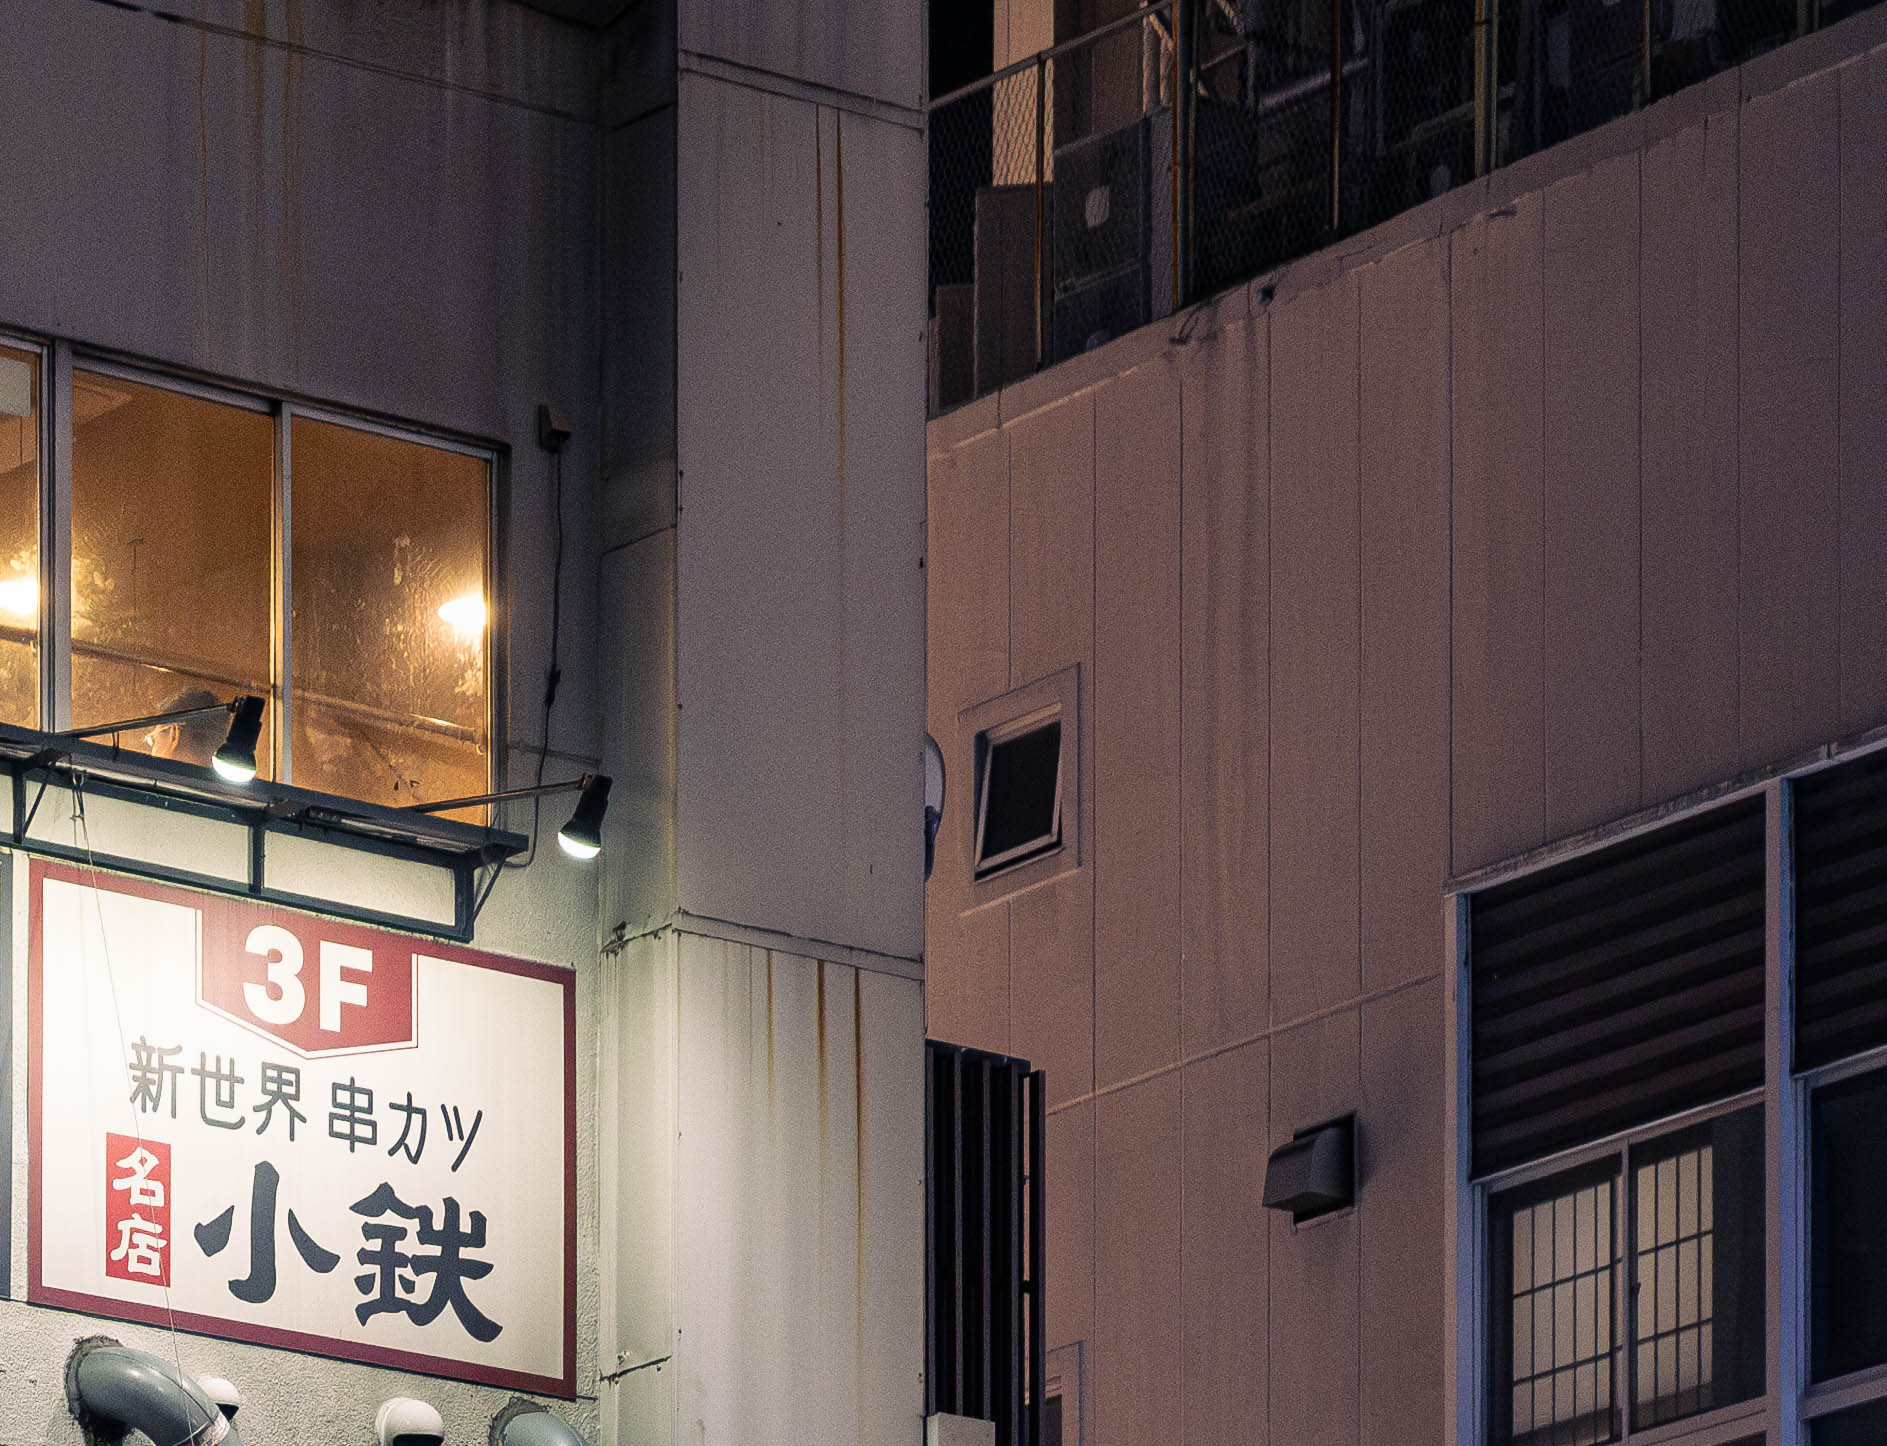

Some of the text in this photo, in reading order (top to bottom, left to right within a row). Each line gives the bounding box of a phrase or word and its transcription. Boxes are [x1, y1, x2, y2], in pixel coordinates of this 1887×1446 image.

[242, 926, 374, 1036] 3F
[130, 1038, 483, 1174] 新世界 串カツ
[109, 1145, 168, 1277] 名店
[194, 1160, 503, 1343] 小鉄
